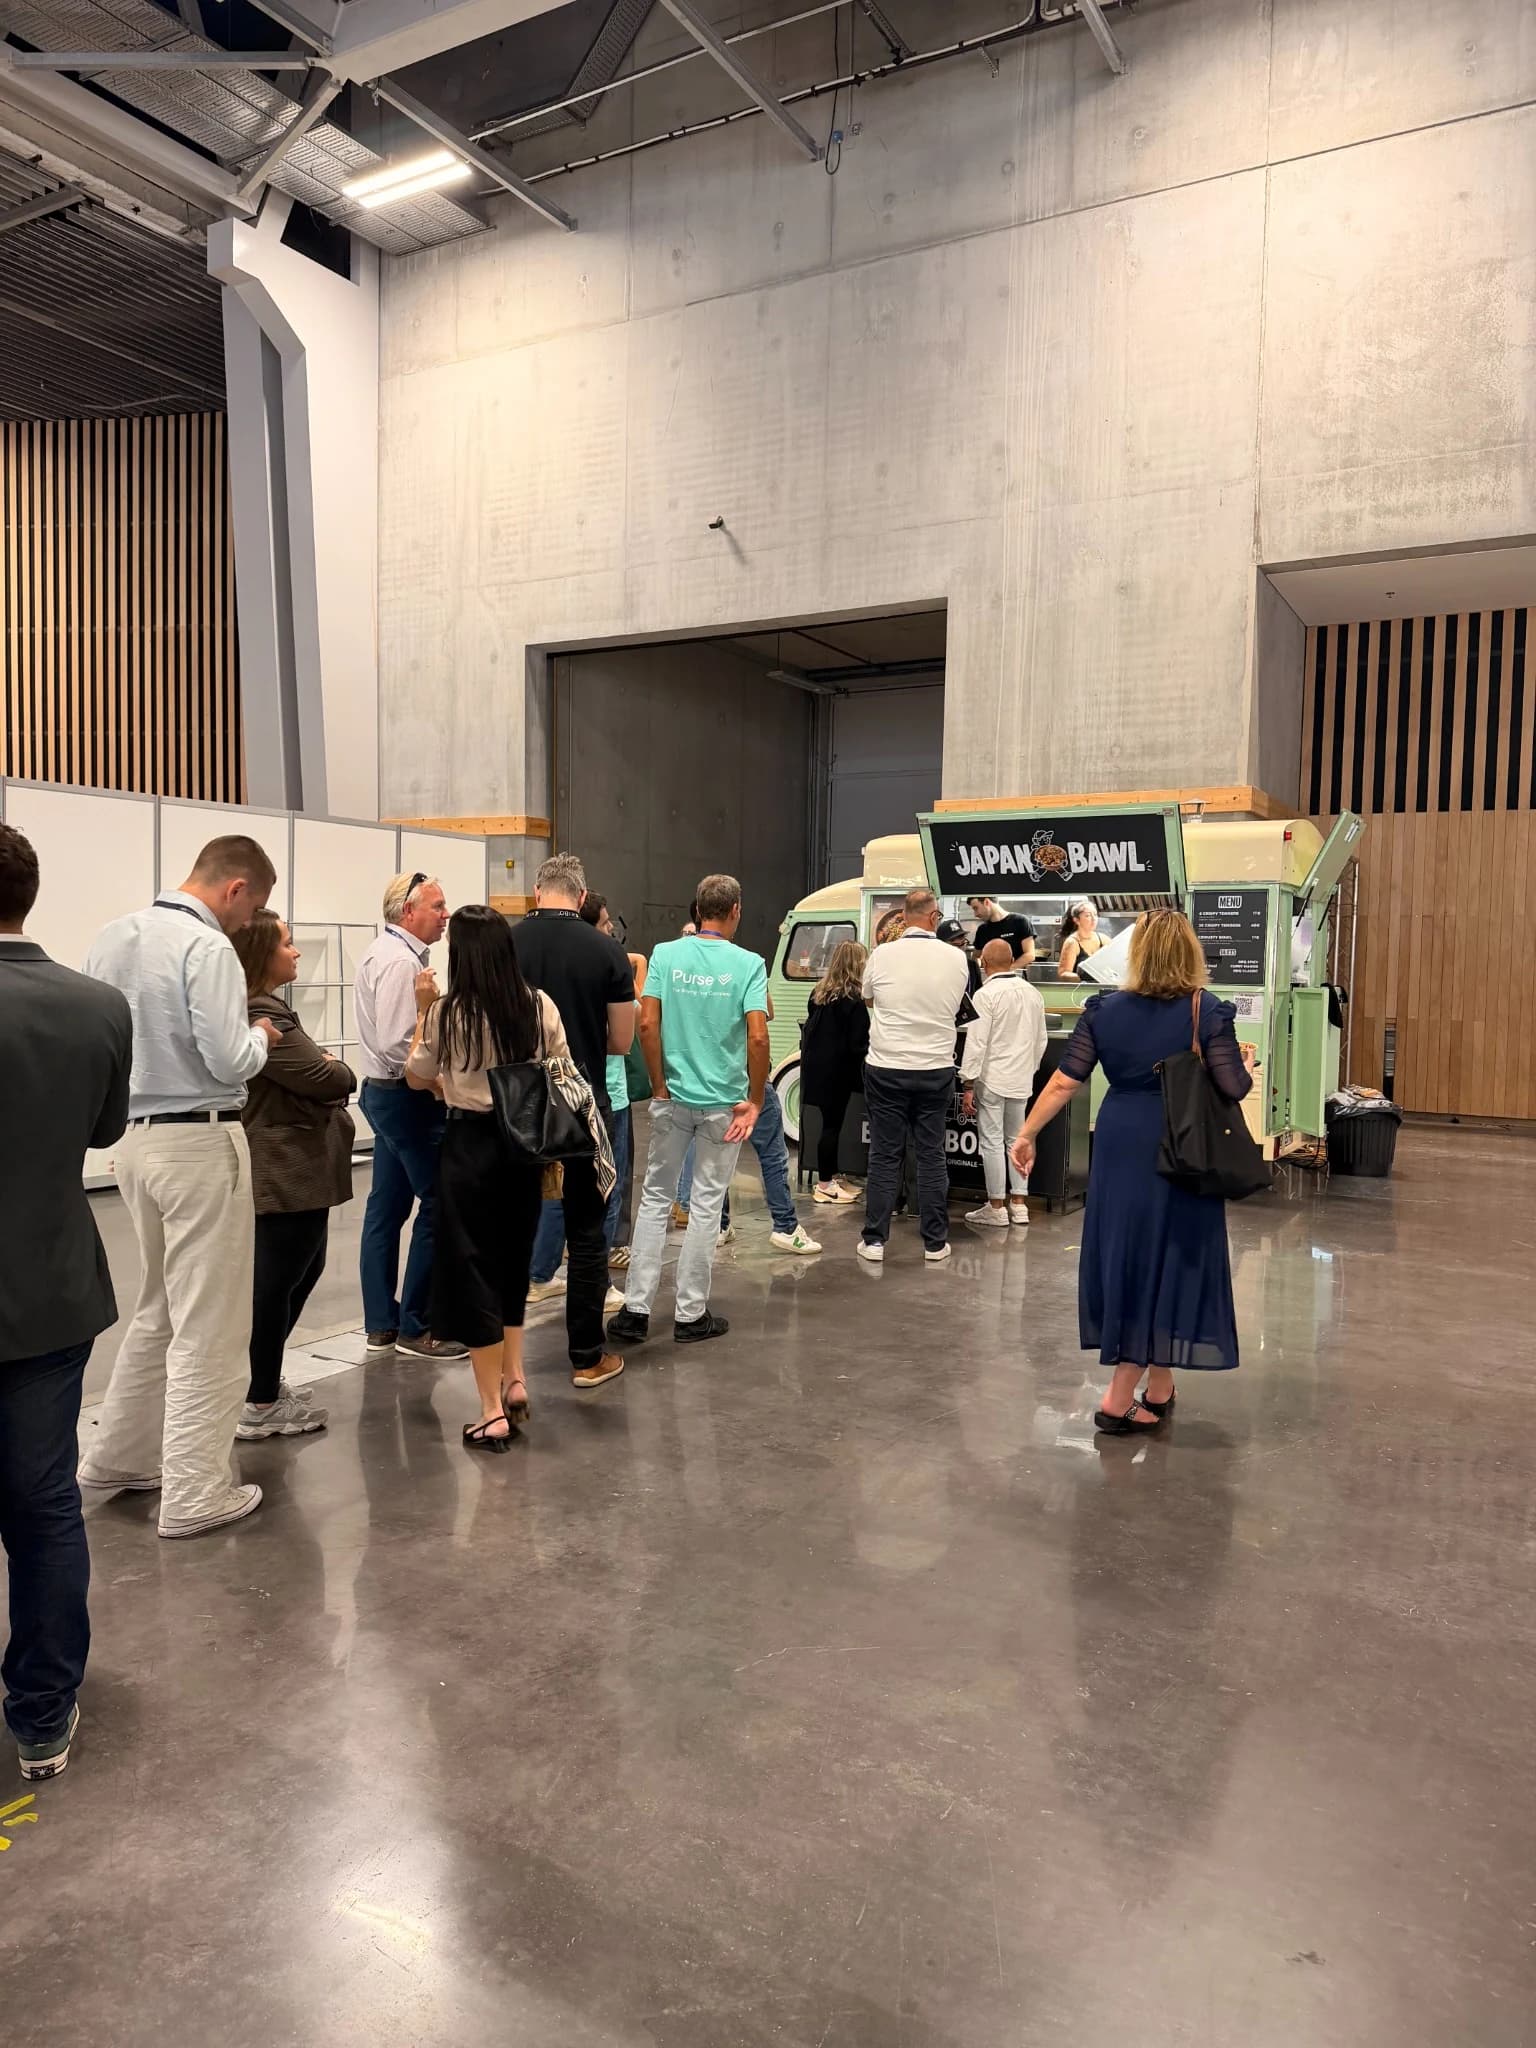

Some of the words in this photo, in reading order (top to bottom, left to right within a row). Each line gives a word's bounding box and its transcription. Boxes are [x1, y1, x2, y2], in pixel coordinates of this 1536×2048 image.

[955, 843, 1035, 877] JAPAN
[1067, 841, 1146, 874] BAWL
[1219, 896, 1241, 908] MENU
[672, 969, 714, 986] Purse
[944, 1129, 983, 1157] BO
